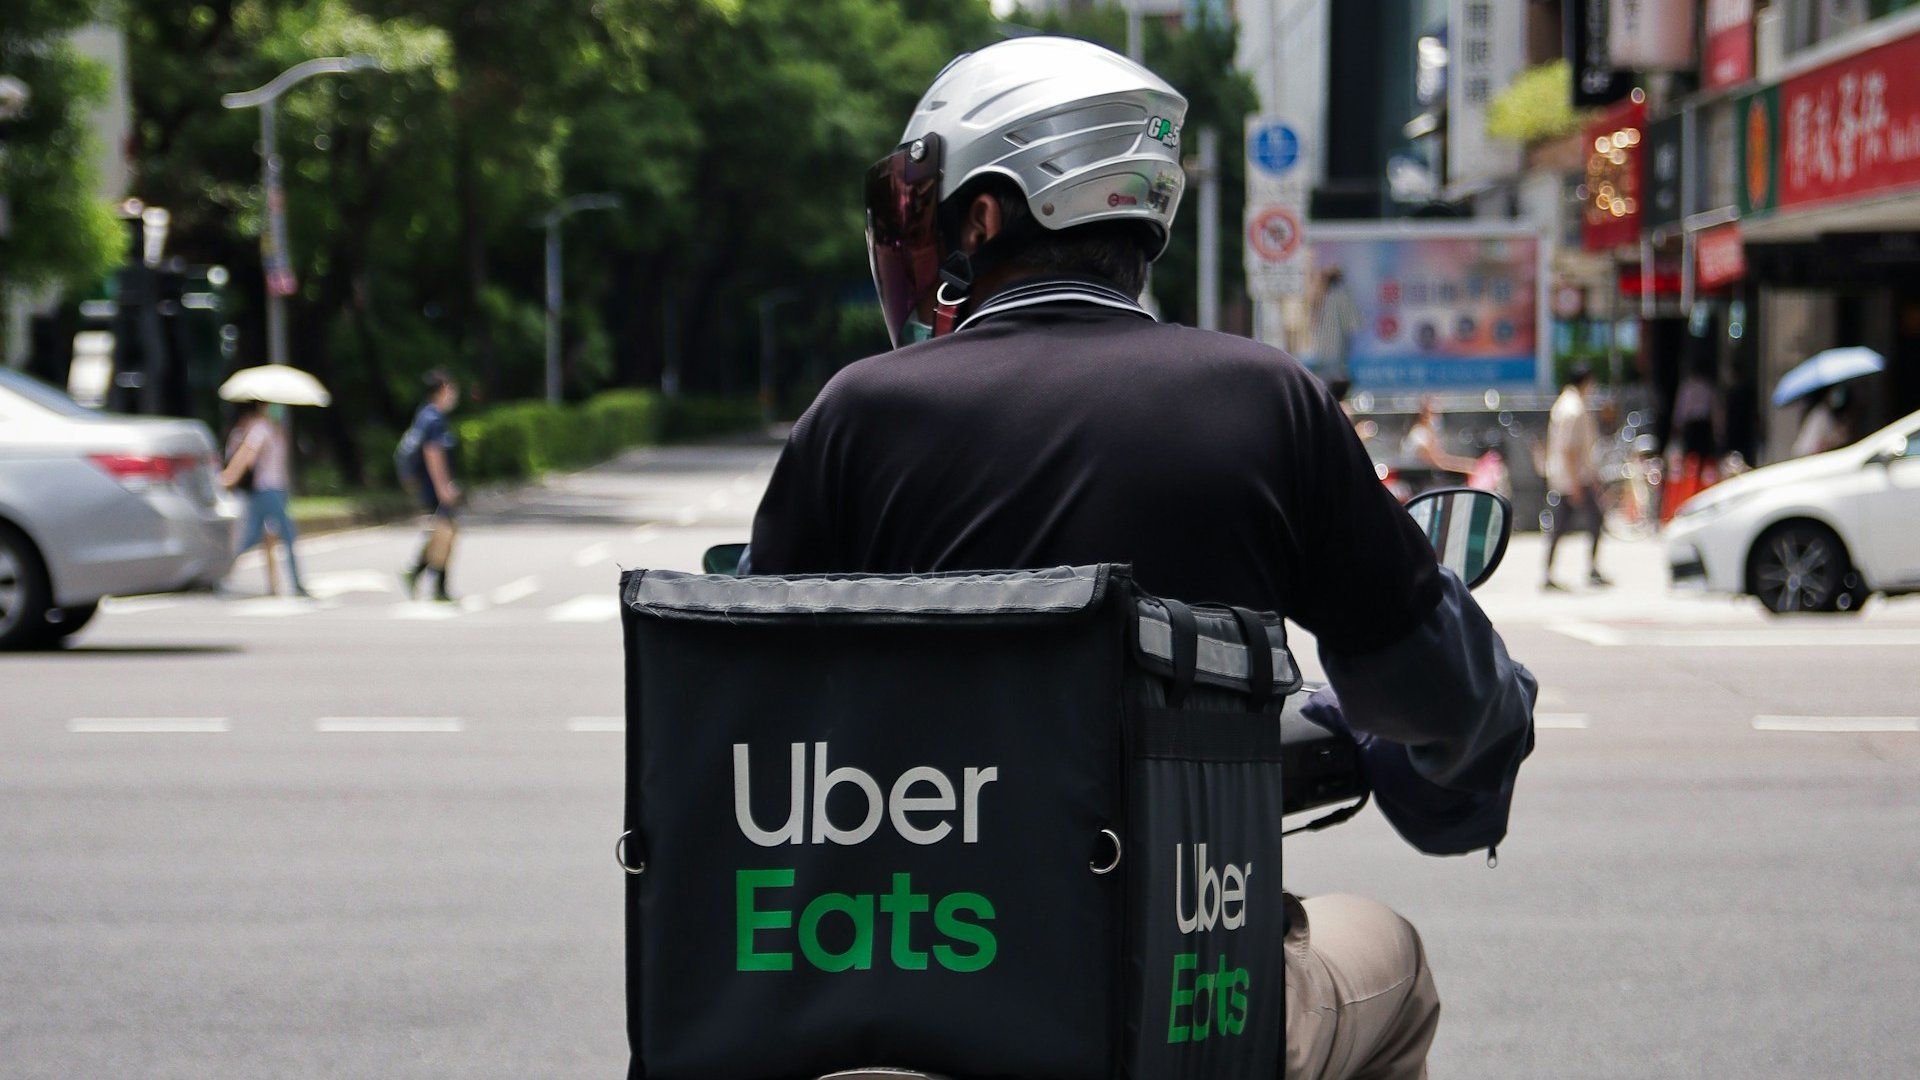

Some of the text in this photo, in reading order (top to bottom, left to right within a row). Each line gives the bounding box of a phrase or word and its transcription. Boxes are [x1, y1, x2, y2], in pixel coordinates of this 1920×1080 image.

[734, 742, 997, 846] Uber
[736, 867, 997, 972] Eats
[1176, 843, 1251, 933] Uber
[1168, 953, 1249, 1043] Eats
